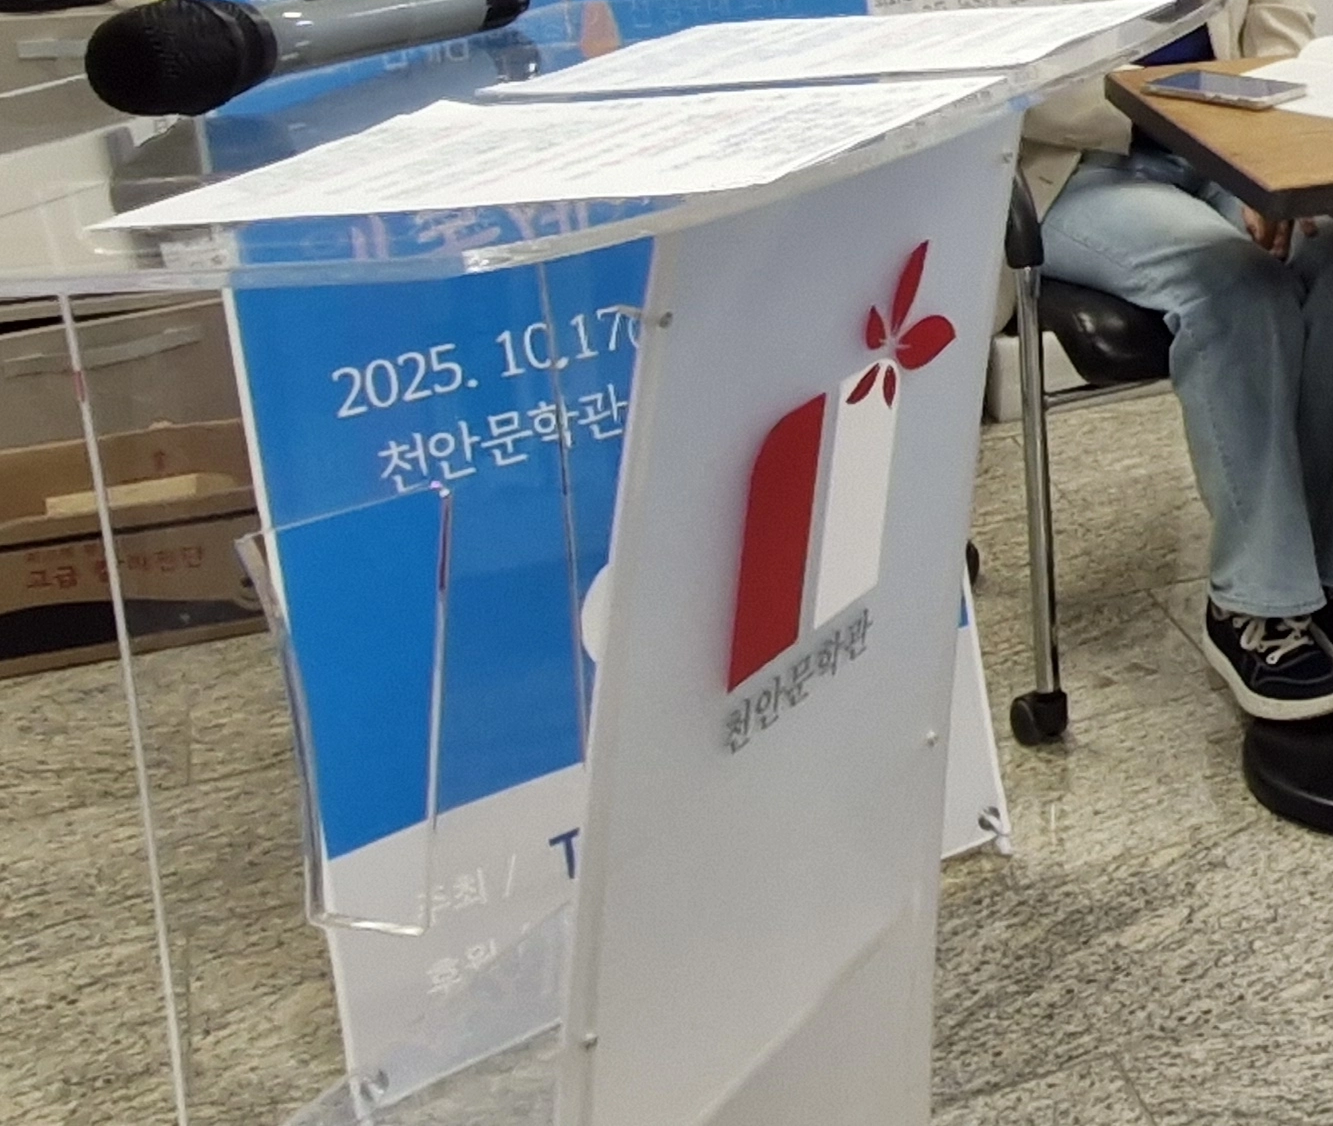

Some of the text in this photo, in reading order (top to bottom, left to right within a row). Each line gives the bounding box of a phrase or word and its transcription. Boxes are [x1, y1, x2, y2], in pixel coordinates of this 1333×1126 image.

[331, 342, 480, 421] 2025.
[377, 380, 630, 493] 천안문학관
[722, 606, 876, 755] 천안문학관
